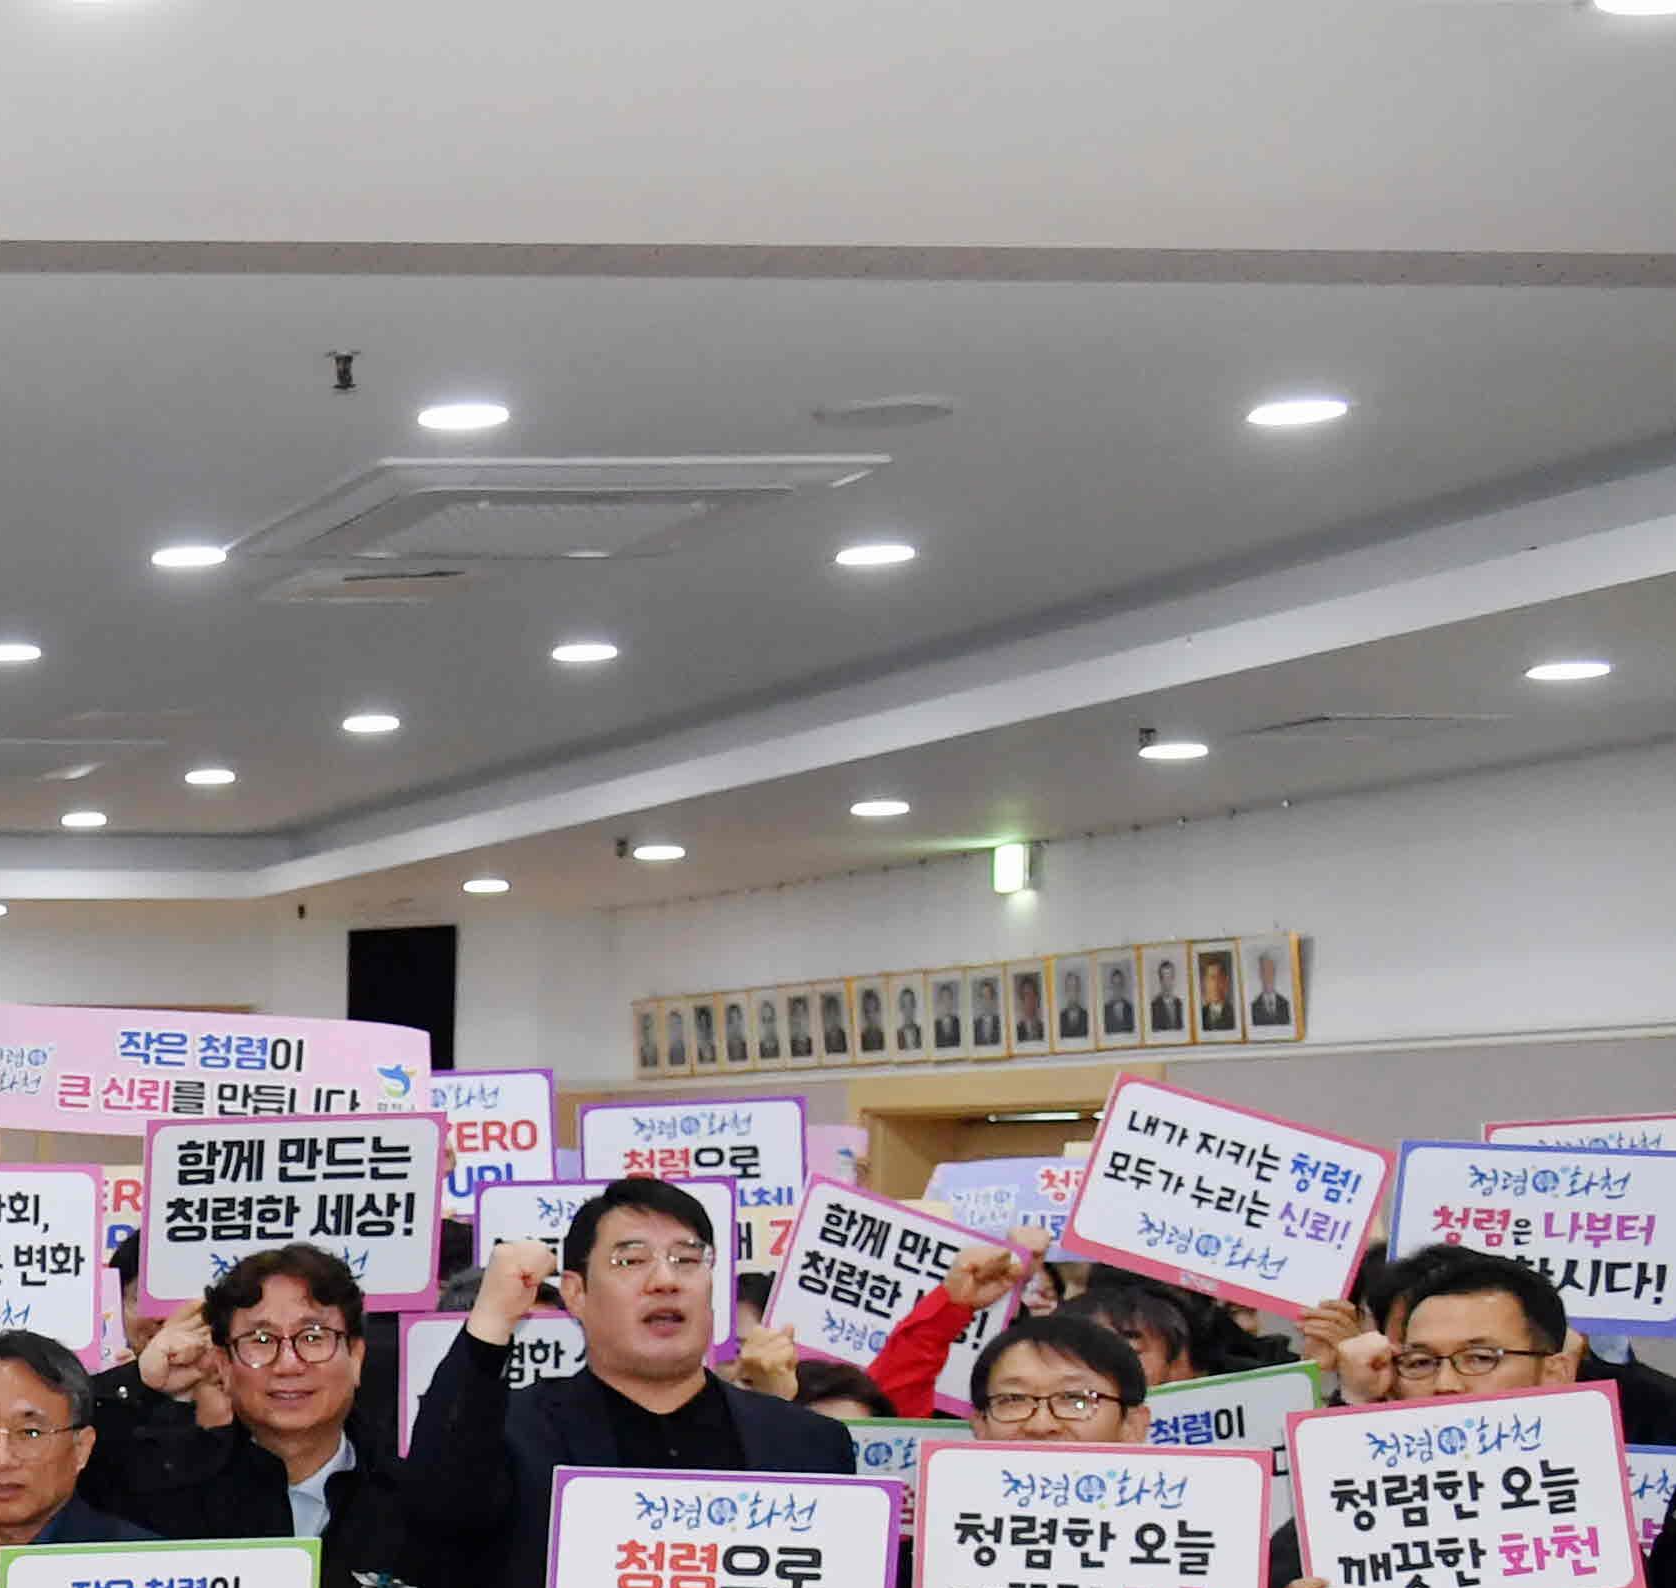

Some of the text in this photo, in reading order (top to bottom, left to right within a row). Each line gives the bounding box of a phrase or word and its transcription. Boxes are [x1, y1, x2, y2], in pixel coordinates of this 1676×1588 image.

[119, 1032, 304, 1071] 작은 청렴이
[58, 1076, 90, 1109] 큰
[103, 1077, 205, 1114] 신뢰를
[178, 1136, 412, 1186] 함께 만드는
[448, 1120, 537, 1152] ERO
[1128, 1111, 1362, 1203] 내가 지키는 청렴!
[166, 1193, 300, 1243] 청렴한
[311, 1192, 415, 1239] 세상!
[1105, 1152, 1185, 1195] 모두가
[1191, 1176, 1271, 1229] 누리는
[1280, 1202, 1351, 1249] 신뢰!
[820, 1203, 891, 1260] 함께
[895, 1228, 961, 1280] 만드
[1433, 1206, 1657, 1248] 청렴은 나부터
[14, 1243, 85, 1288] 변화
[799, 1250, 901, 1319] 청렴한
[1331, 1470, 1484, 1531] 청렴한
[1501, 1459, 1579, 1515] 오늘
[954, 1512, 1216, 1575] 청렴한 오늘
[1498, 1524, 1601, 1577] 화천
